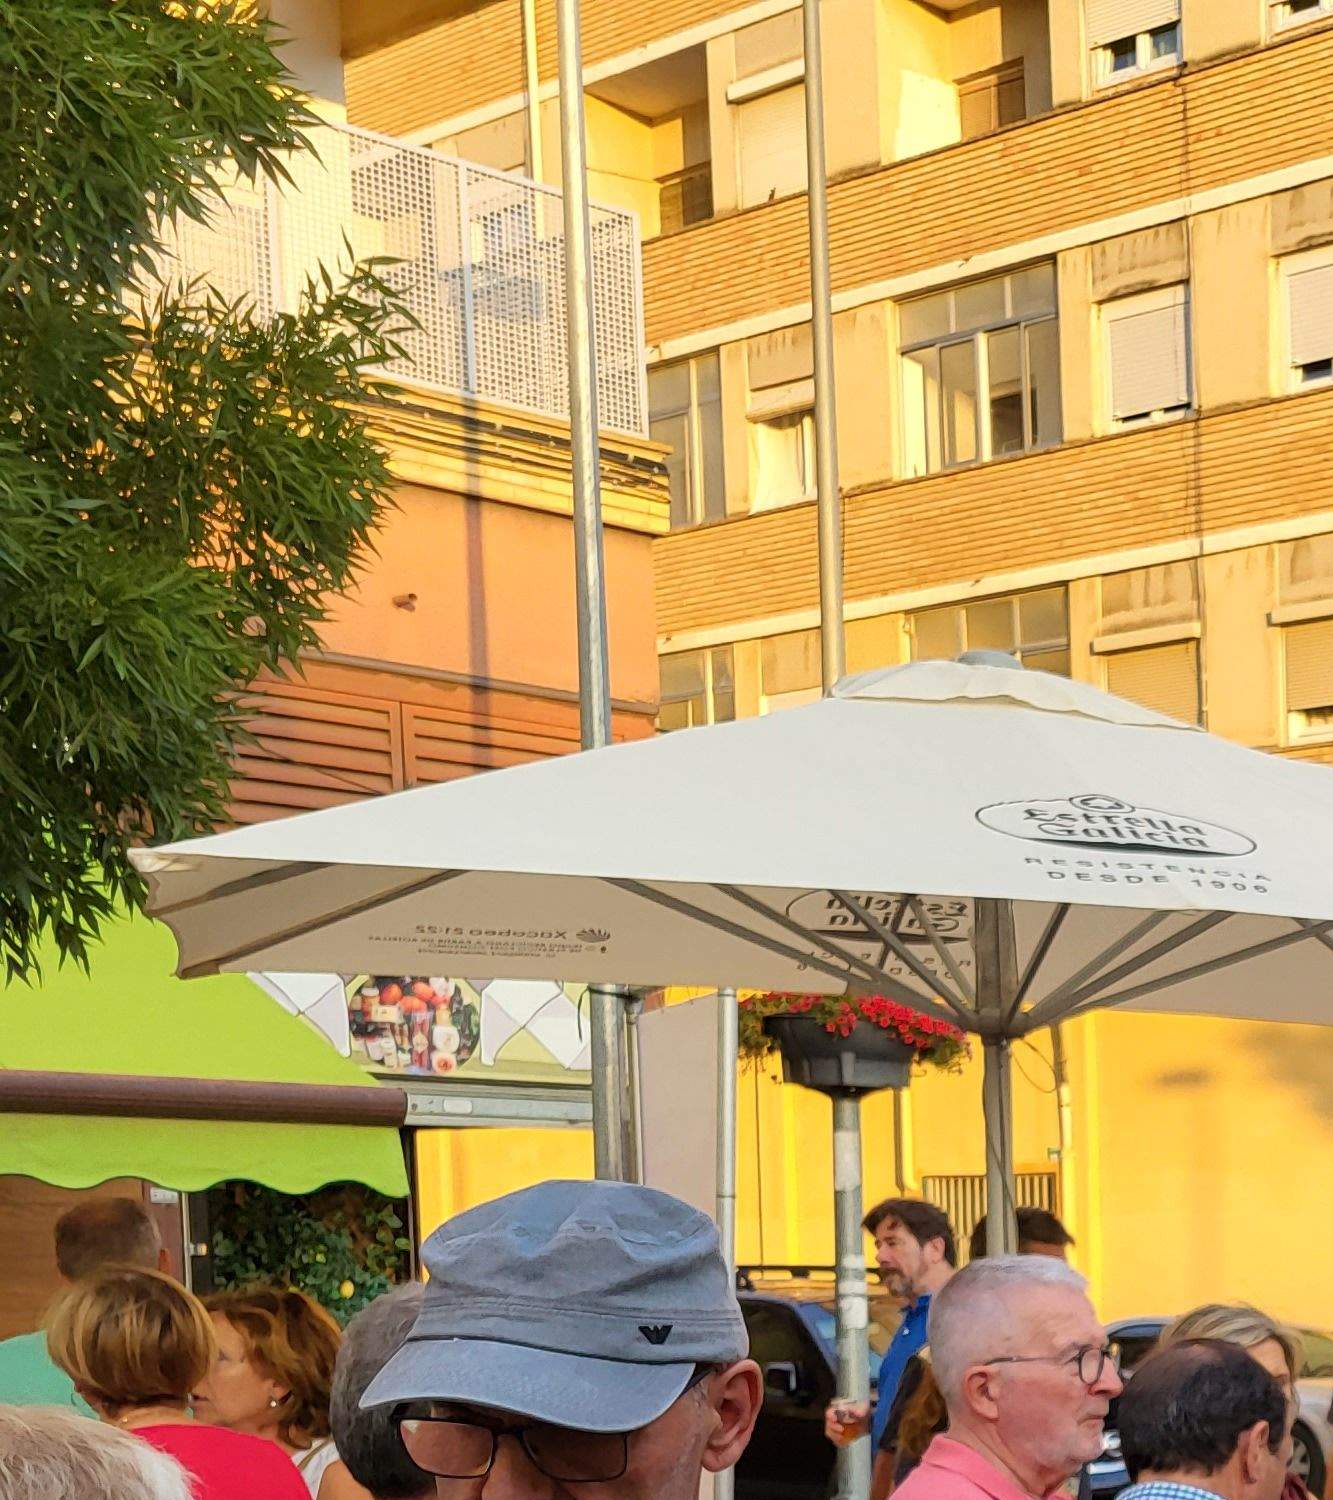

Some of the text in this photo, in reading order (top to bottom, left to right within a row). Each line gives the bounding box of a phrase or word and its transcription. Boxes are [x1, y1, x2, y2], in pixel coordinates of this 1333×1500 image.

[1023, 807, 1208, 837] Estrella
[1036, 822, 1211, 849] Galicia
[1024, 857, 1272, 883] RESISTENCIA
[1047, 871, 1169, 884] DESDE
